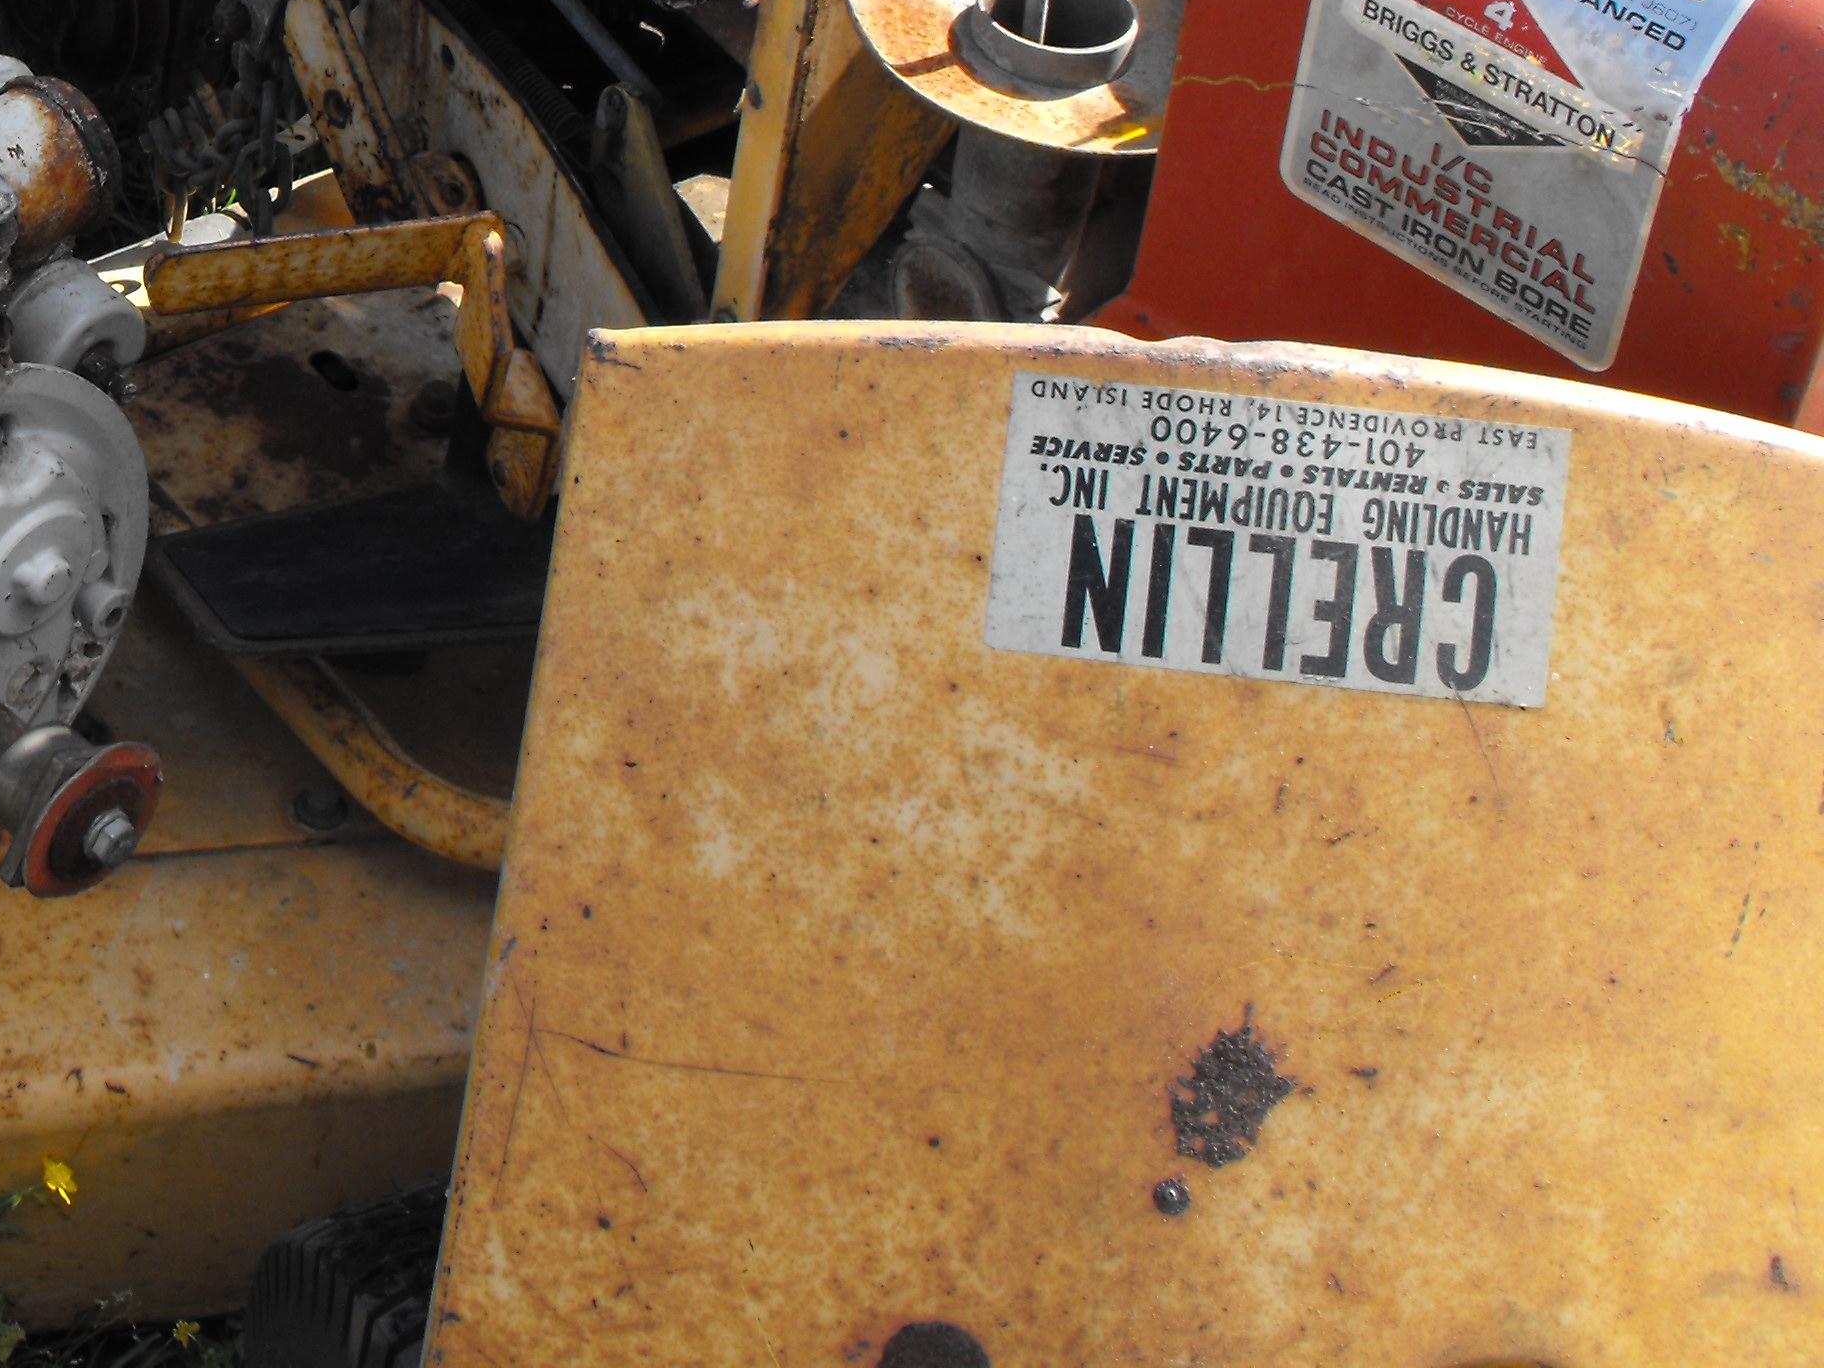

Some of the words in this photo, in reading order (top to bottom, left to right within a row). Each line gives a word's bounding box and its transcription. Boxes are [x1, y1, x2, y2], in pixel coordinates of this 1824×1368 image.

[1445, 6, 1489, 35] CYCLE
[1494, 32, 1549, 66] ENGINE
[1483, 0, 1517, 31] 4
[1459, 51, 1476, 75] &
[1483, 63, 1617, 149] STRATTON
[1430, 142, 1495, 194] I/C
[1319, 108, 1596, 284] INDUSTRIAL
[1310, 131, 1597, 315] COMMERCIAL
[1305, 158, 1395, 220] CAST
[1400, 213, 1485, 277] IRON
[1493, 267, 1593, 340] BORE
[1451, 263, 1510, 304] BEFORE
[1512, 300, 1588, 352] STARTING
[1030, 379, 1128, 407] ISLAND
[1140, 389, 1233, 417] RHODE
[1246, 396, 1283, 423] 14,
[1150, 414, 1426, 470] 401-438-6400
[1295, 406, 1463, 443] PROVIDENCE
[1477, 426, 1539, 450] EAST
[1029, 434, 1148, 466] SERVICE
[1177, 450, 1274, 480] PARTS
[1039, 462, 1110, 511] INC.
[1300, 463, 1428, 495] RENTALS
[1457, 479, 1545, 507] SALES
[1135, 473, 1335, 536] EQUIPMENT
[1361, 497, 1533, 557] HANDLING
[1060, 512, 1498, 692] CRELLIN
